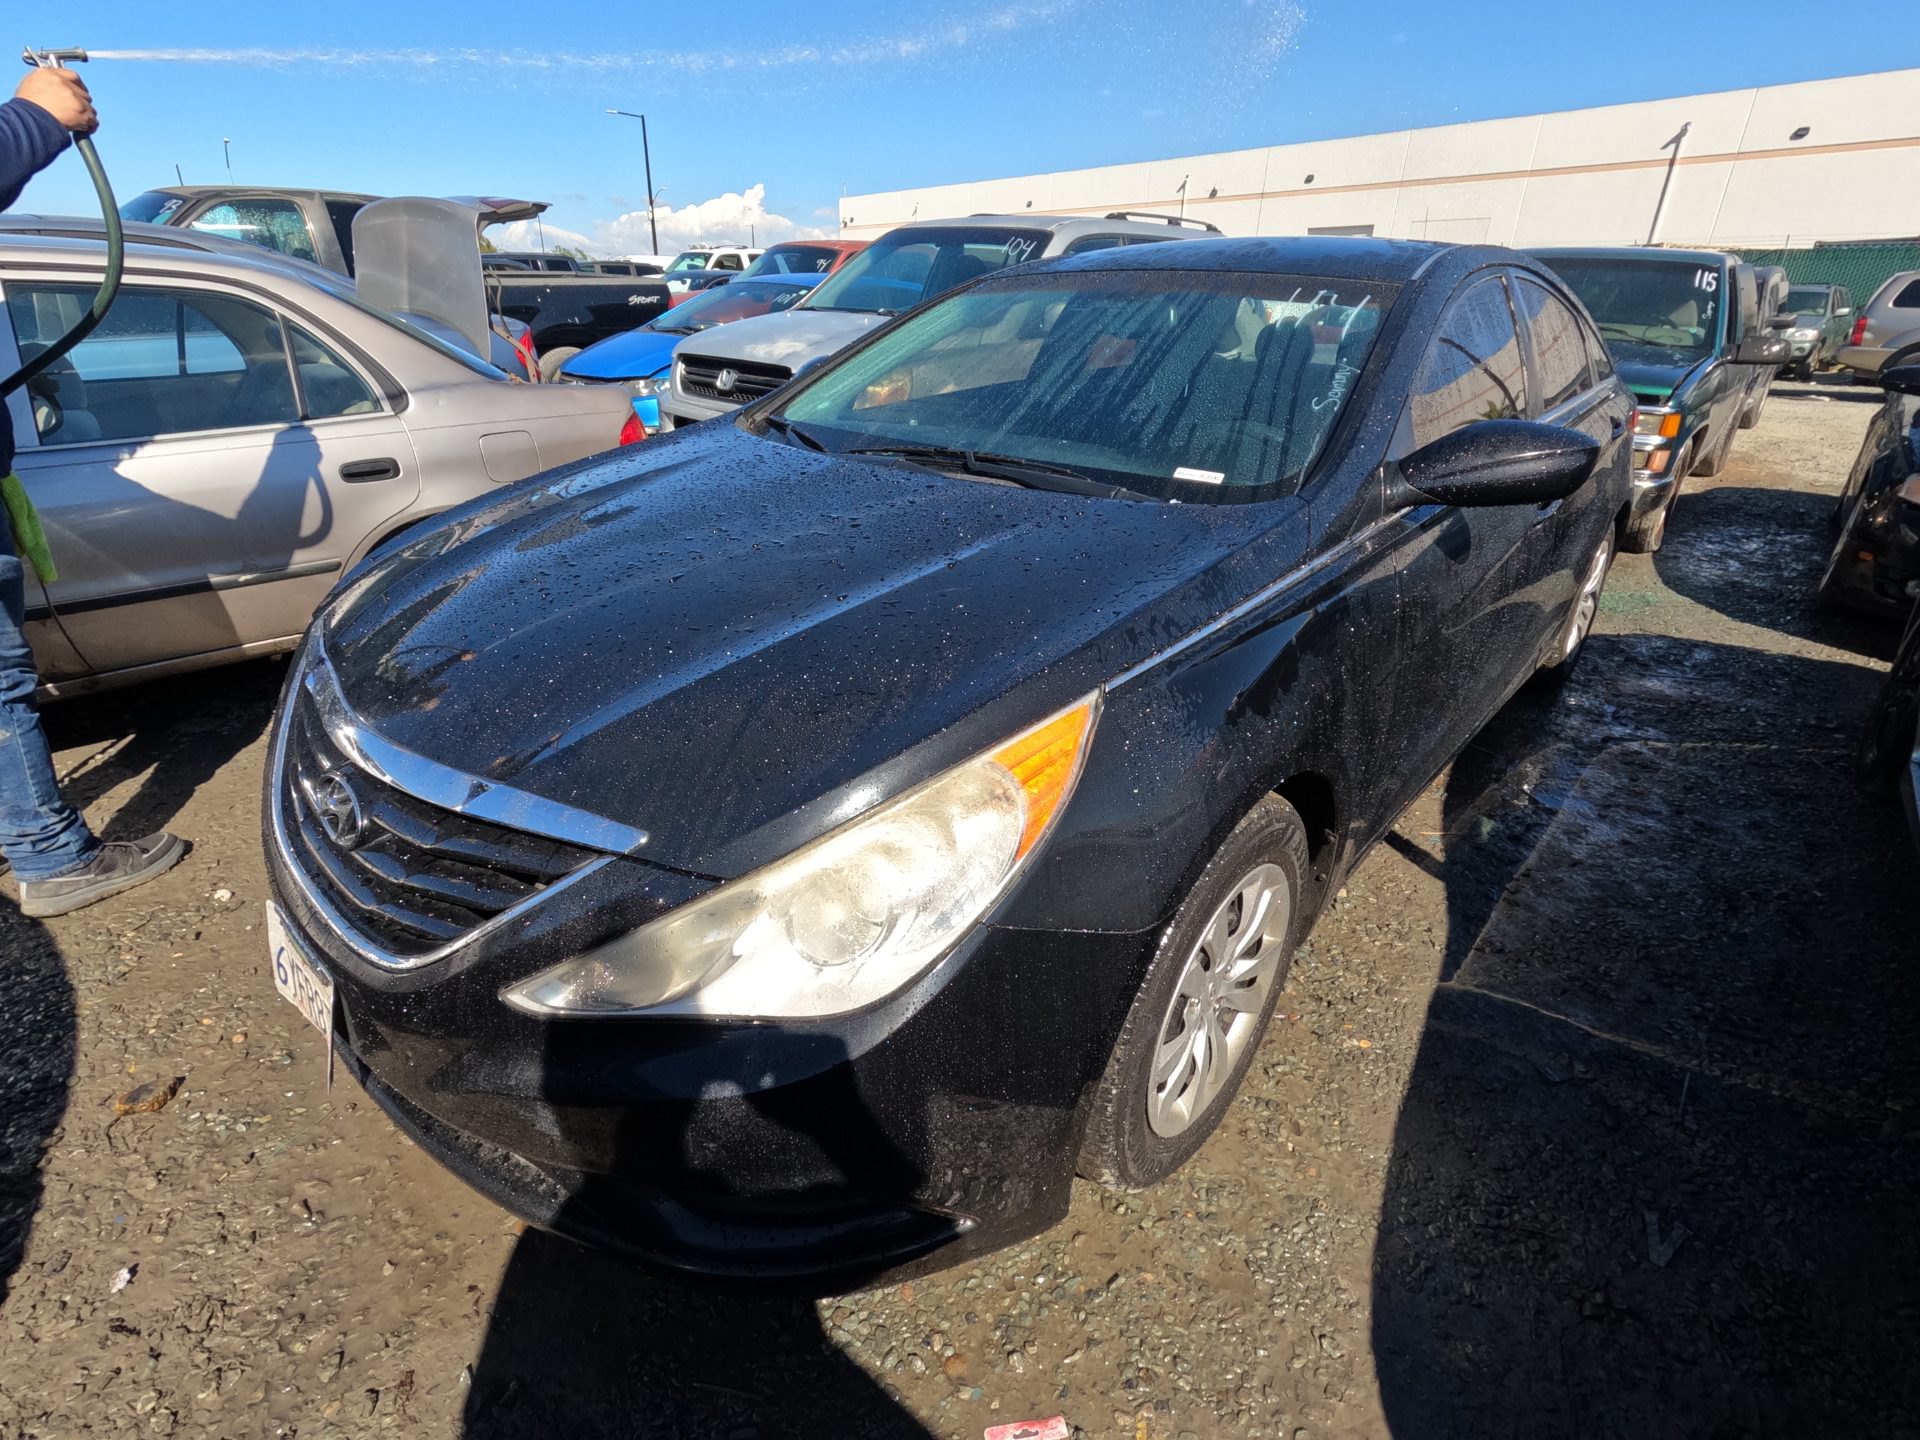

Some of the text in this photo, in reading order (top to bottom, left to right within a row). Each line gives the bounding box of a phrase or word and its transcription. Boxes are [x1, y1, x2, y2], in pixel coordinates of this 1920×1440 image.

[1001, 235, 1038, 262] 104
[1694, 268, 1719, 292] 115
[628, 294, 661, 306] SPORT
